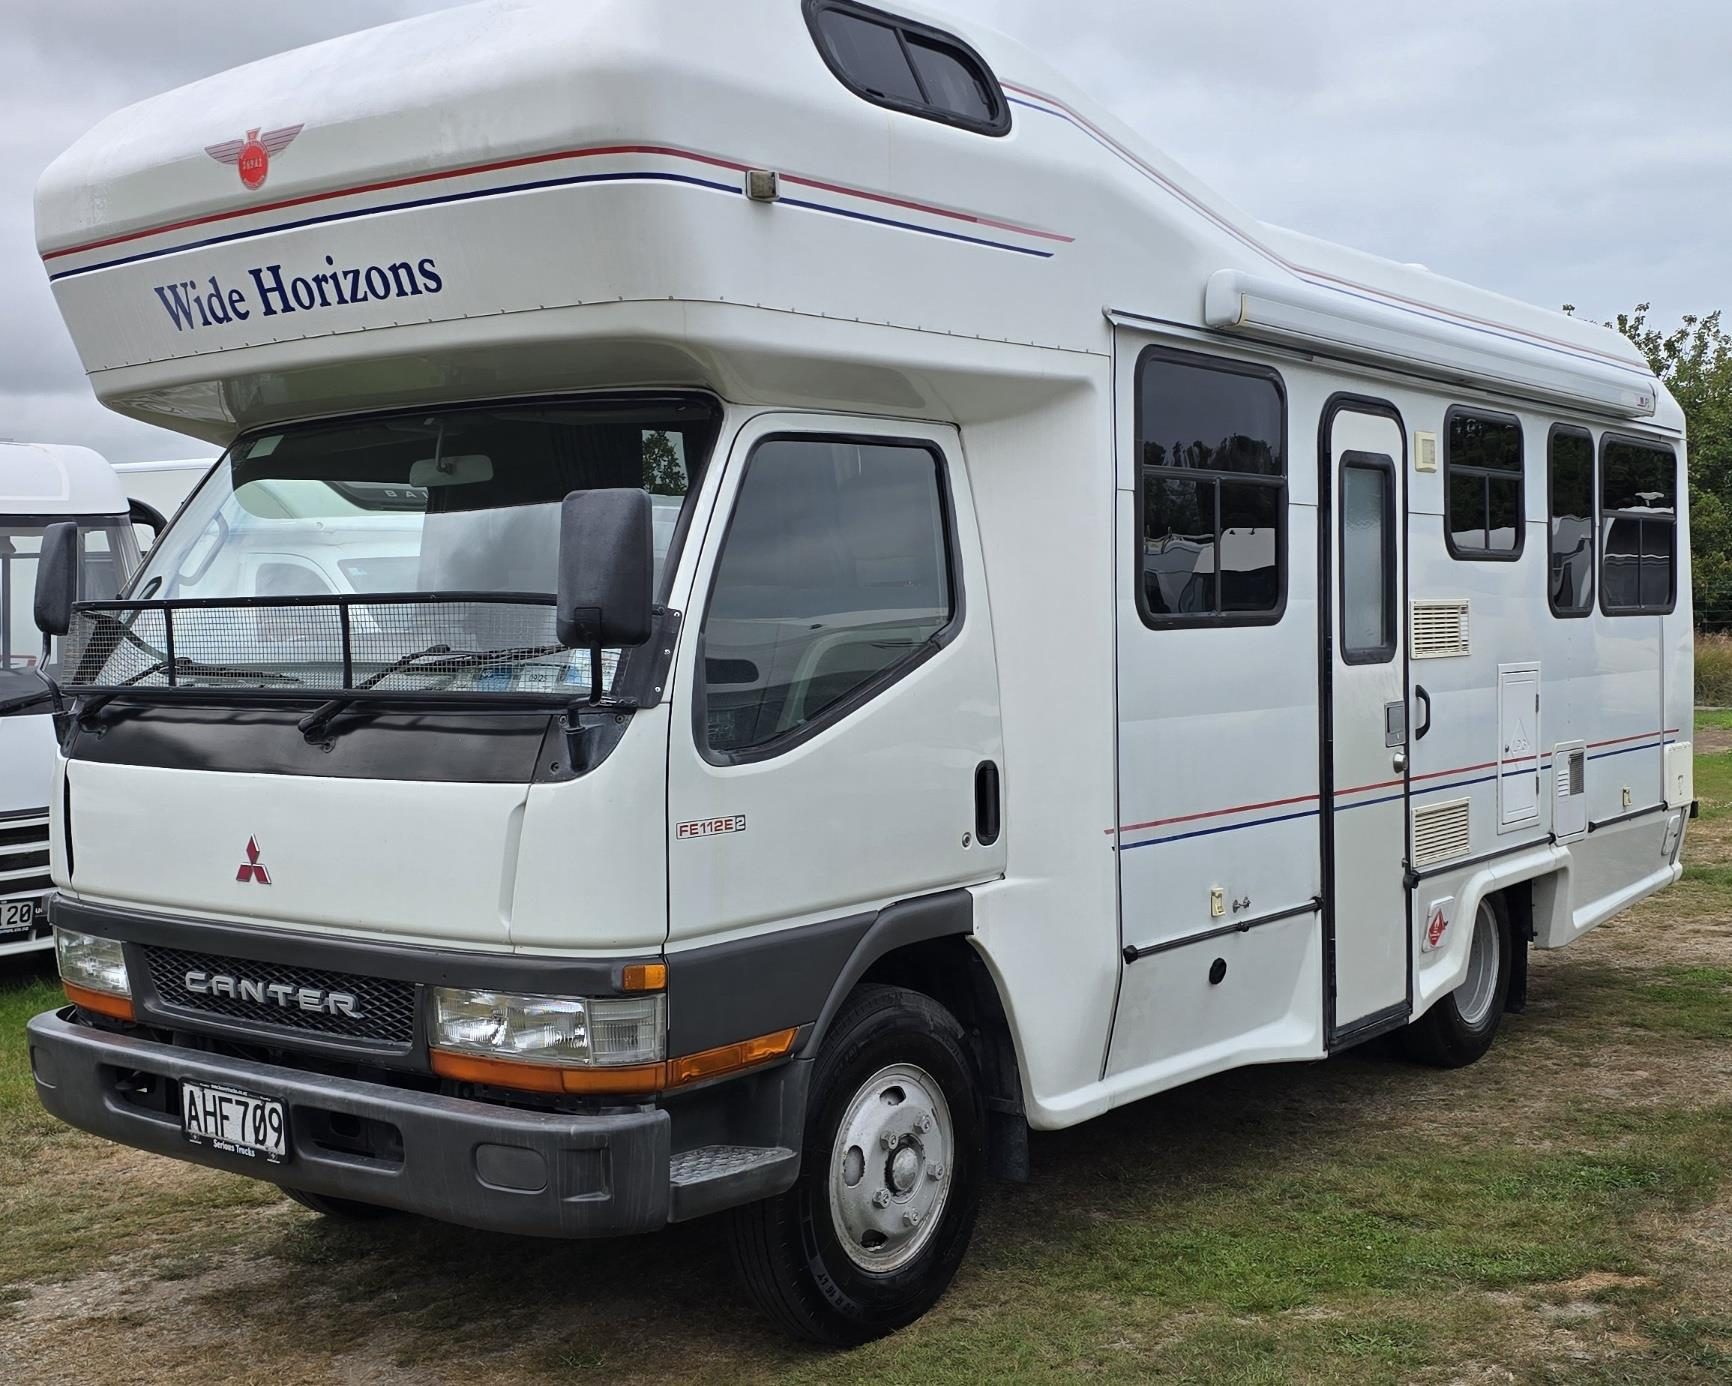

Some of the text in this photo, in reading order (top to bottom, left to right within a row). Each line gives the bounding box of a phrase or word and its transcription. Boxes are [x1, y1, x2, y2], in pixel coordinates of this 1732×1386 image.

[154, 255, 443, 332] Wide Horizons
[185, 971, 365, 1019] CANTER
[187, 1089, 283, 1149] AHF709
[213, 1138, 256, 1157] Serious Trucks
